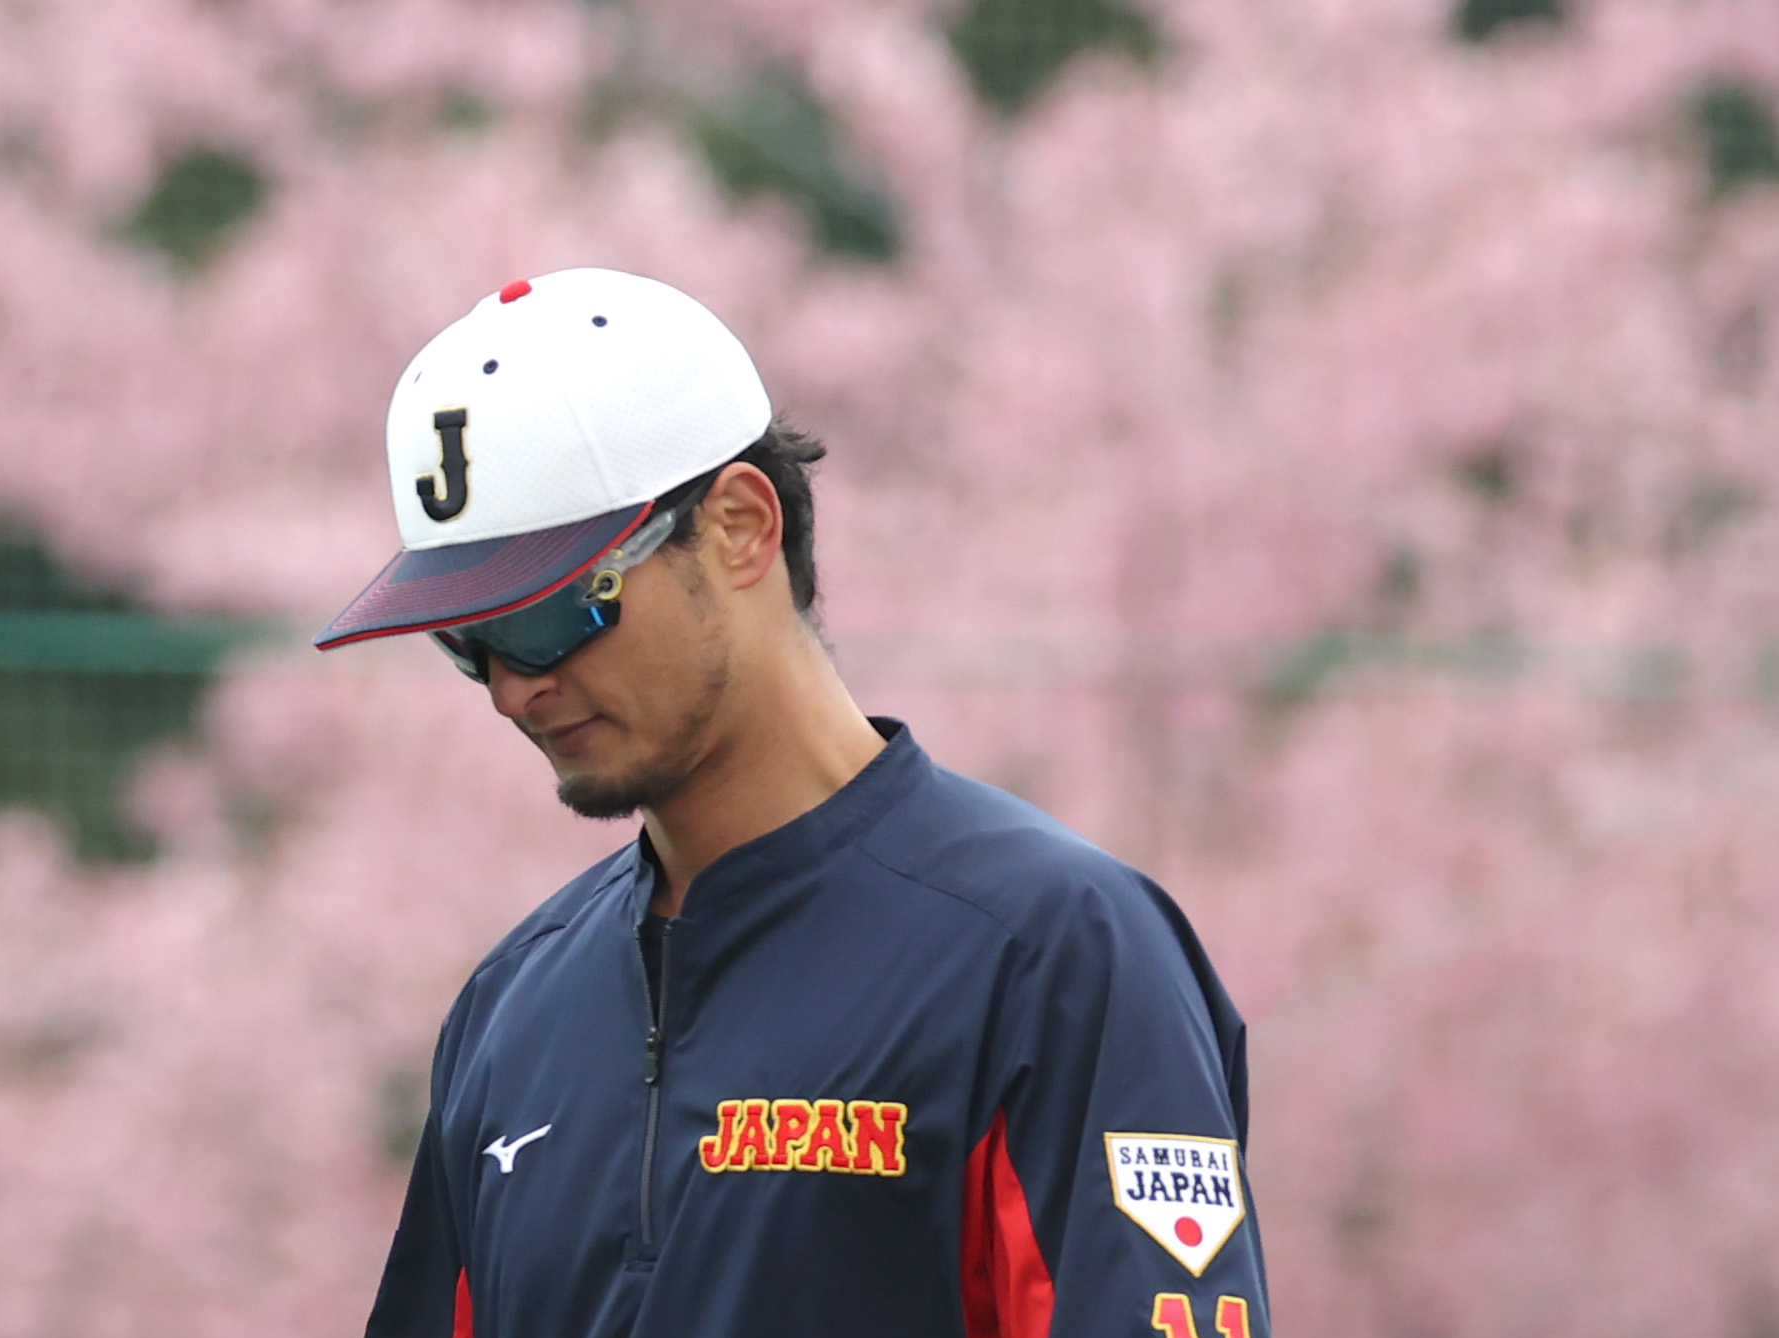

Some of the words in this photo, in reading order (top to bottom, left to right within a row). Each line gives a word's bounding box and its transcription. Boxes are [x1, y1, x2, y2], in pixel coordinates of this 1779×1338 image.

[415, 405, 470, 522] J
[699, 1098, 908, 1177] JAPAN
[1119, 1146, 1230, 1172] SAMURAI
[1126, 1170, 1235, 1208] JAPAN
